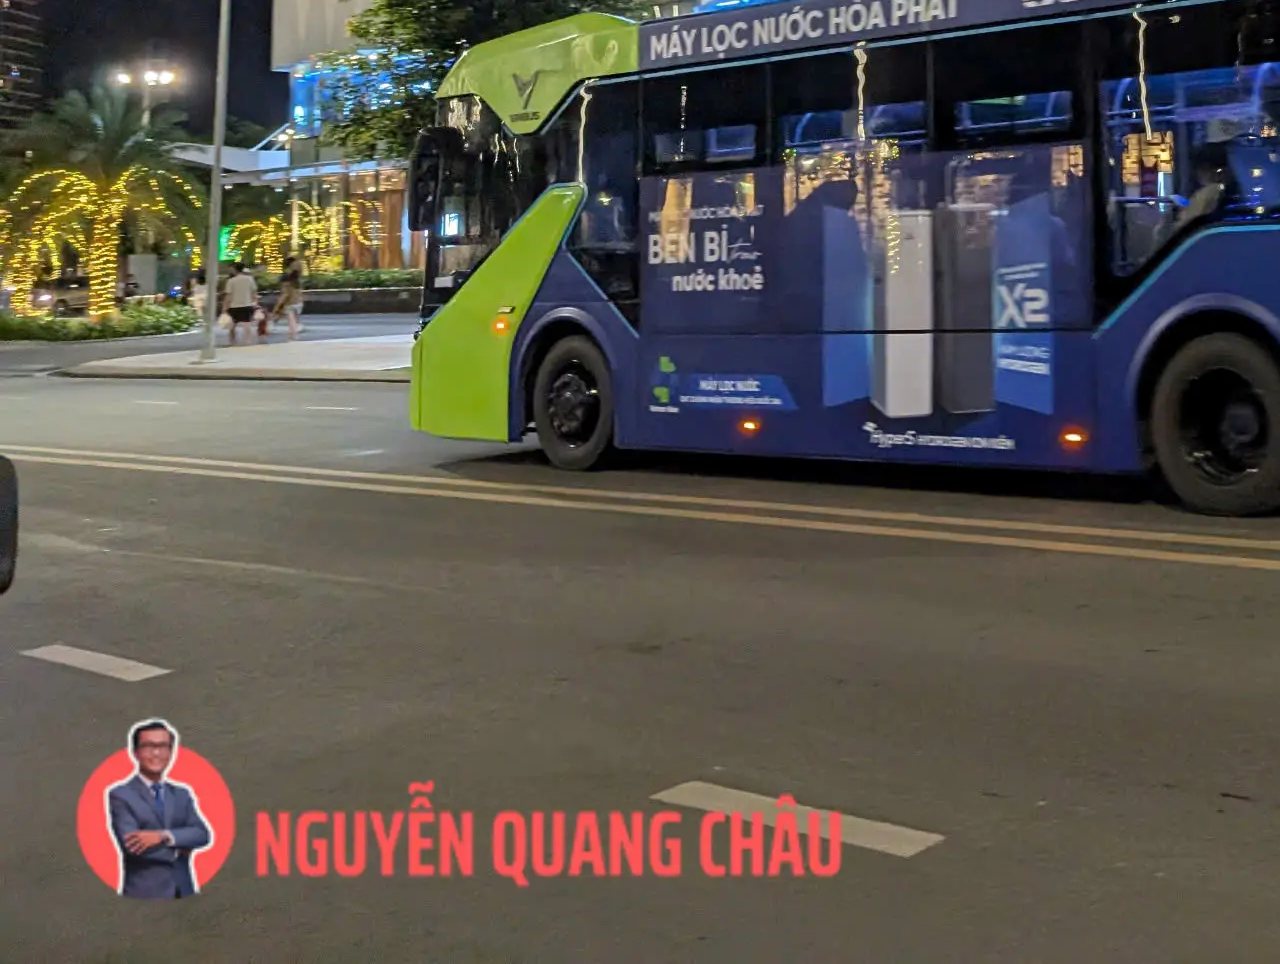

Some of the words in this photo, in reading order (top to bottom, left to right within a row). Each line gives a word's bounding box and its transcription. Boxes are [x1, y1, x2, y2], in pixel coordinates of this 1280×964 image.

[649, 24, 697, 61] MÁY
[702, 21, 749, 59] LỌC
[753, 4, 824, 47] NƯỚC
[672, 268, 716, 292] nước
[996, 282, 1051, 329] X2
